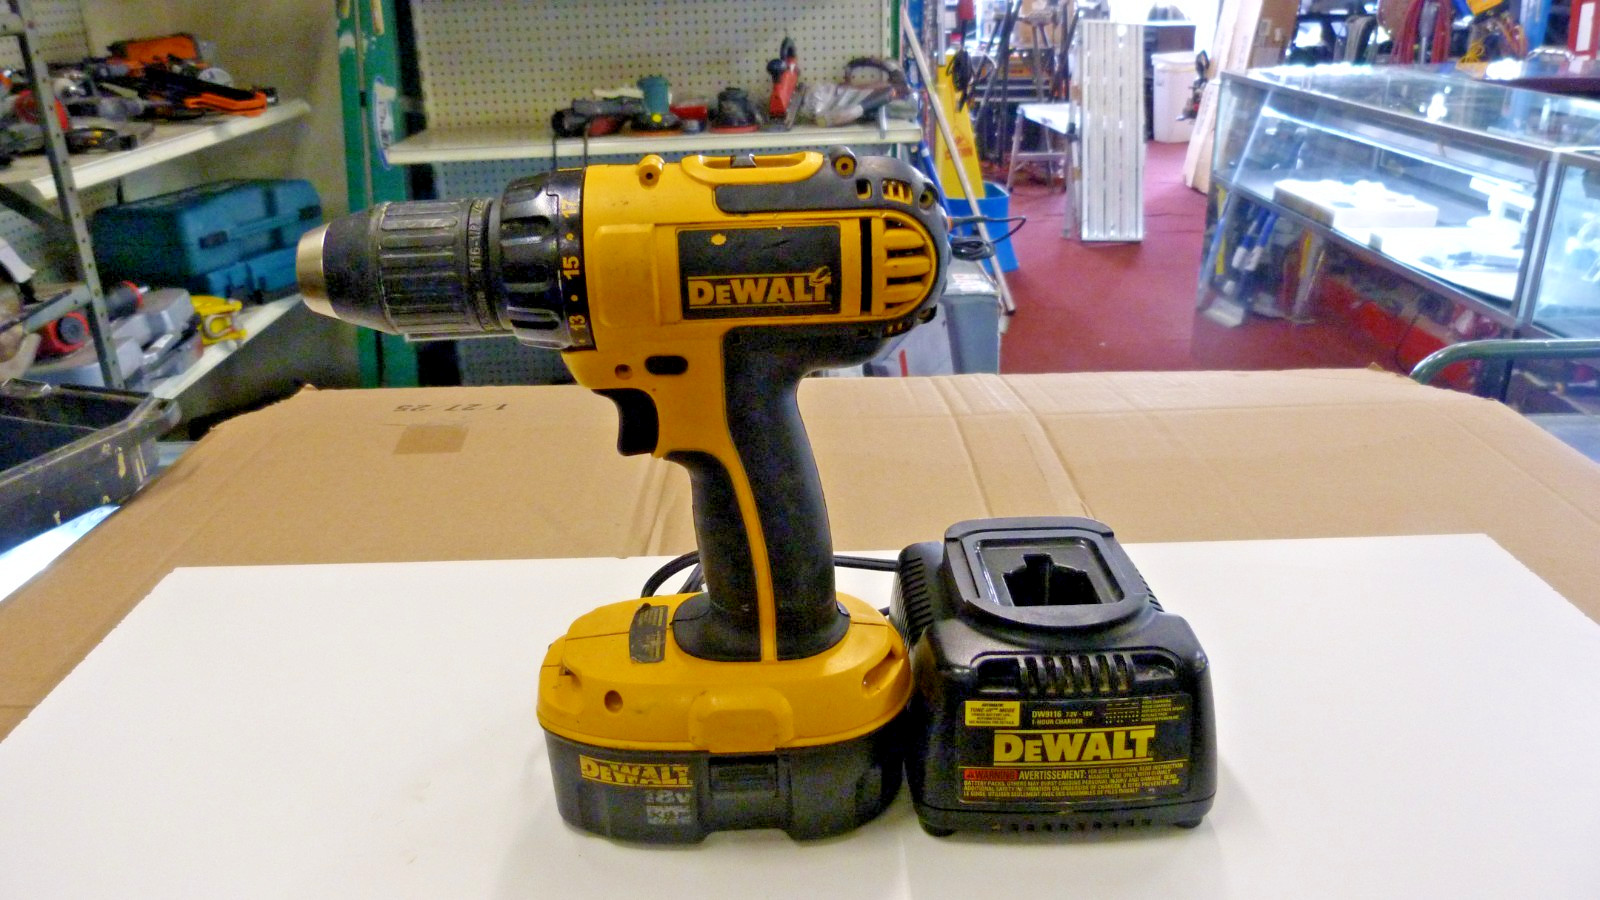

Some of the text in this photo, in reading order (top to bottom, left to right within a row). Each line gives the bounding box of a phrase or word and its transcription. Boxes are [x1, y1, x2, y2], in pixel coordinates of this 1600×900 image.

[561, 198, 577, 218] 17
[562, 255, 581, 280] 15
[568, 313, 586, 331] 13
[1031, 710, 1062, 718] DW9116
[993, 728, 1155, 763] DEWALT
[579, 756, 691, 787] DEWALT
[1018, 769, 1087, 780] AVERTISSEMENT:
